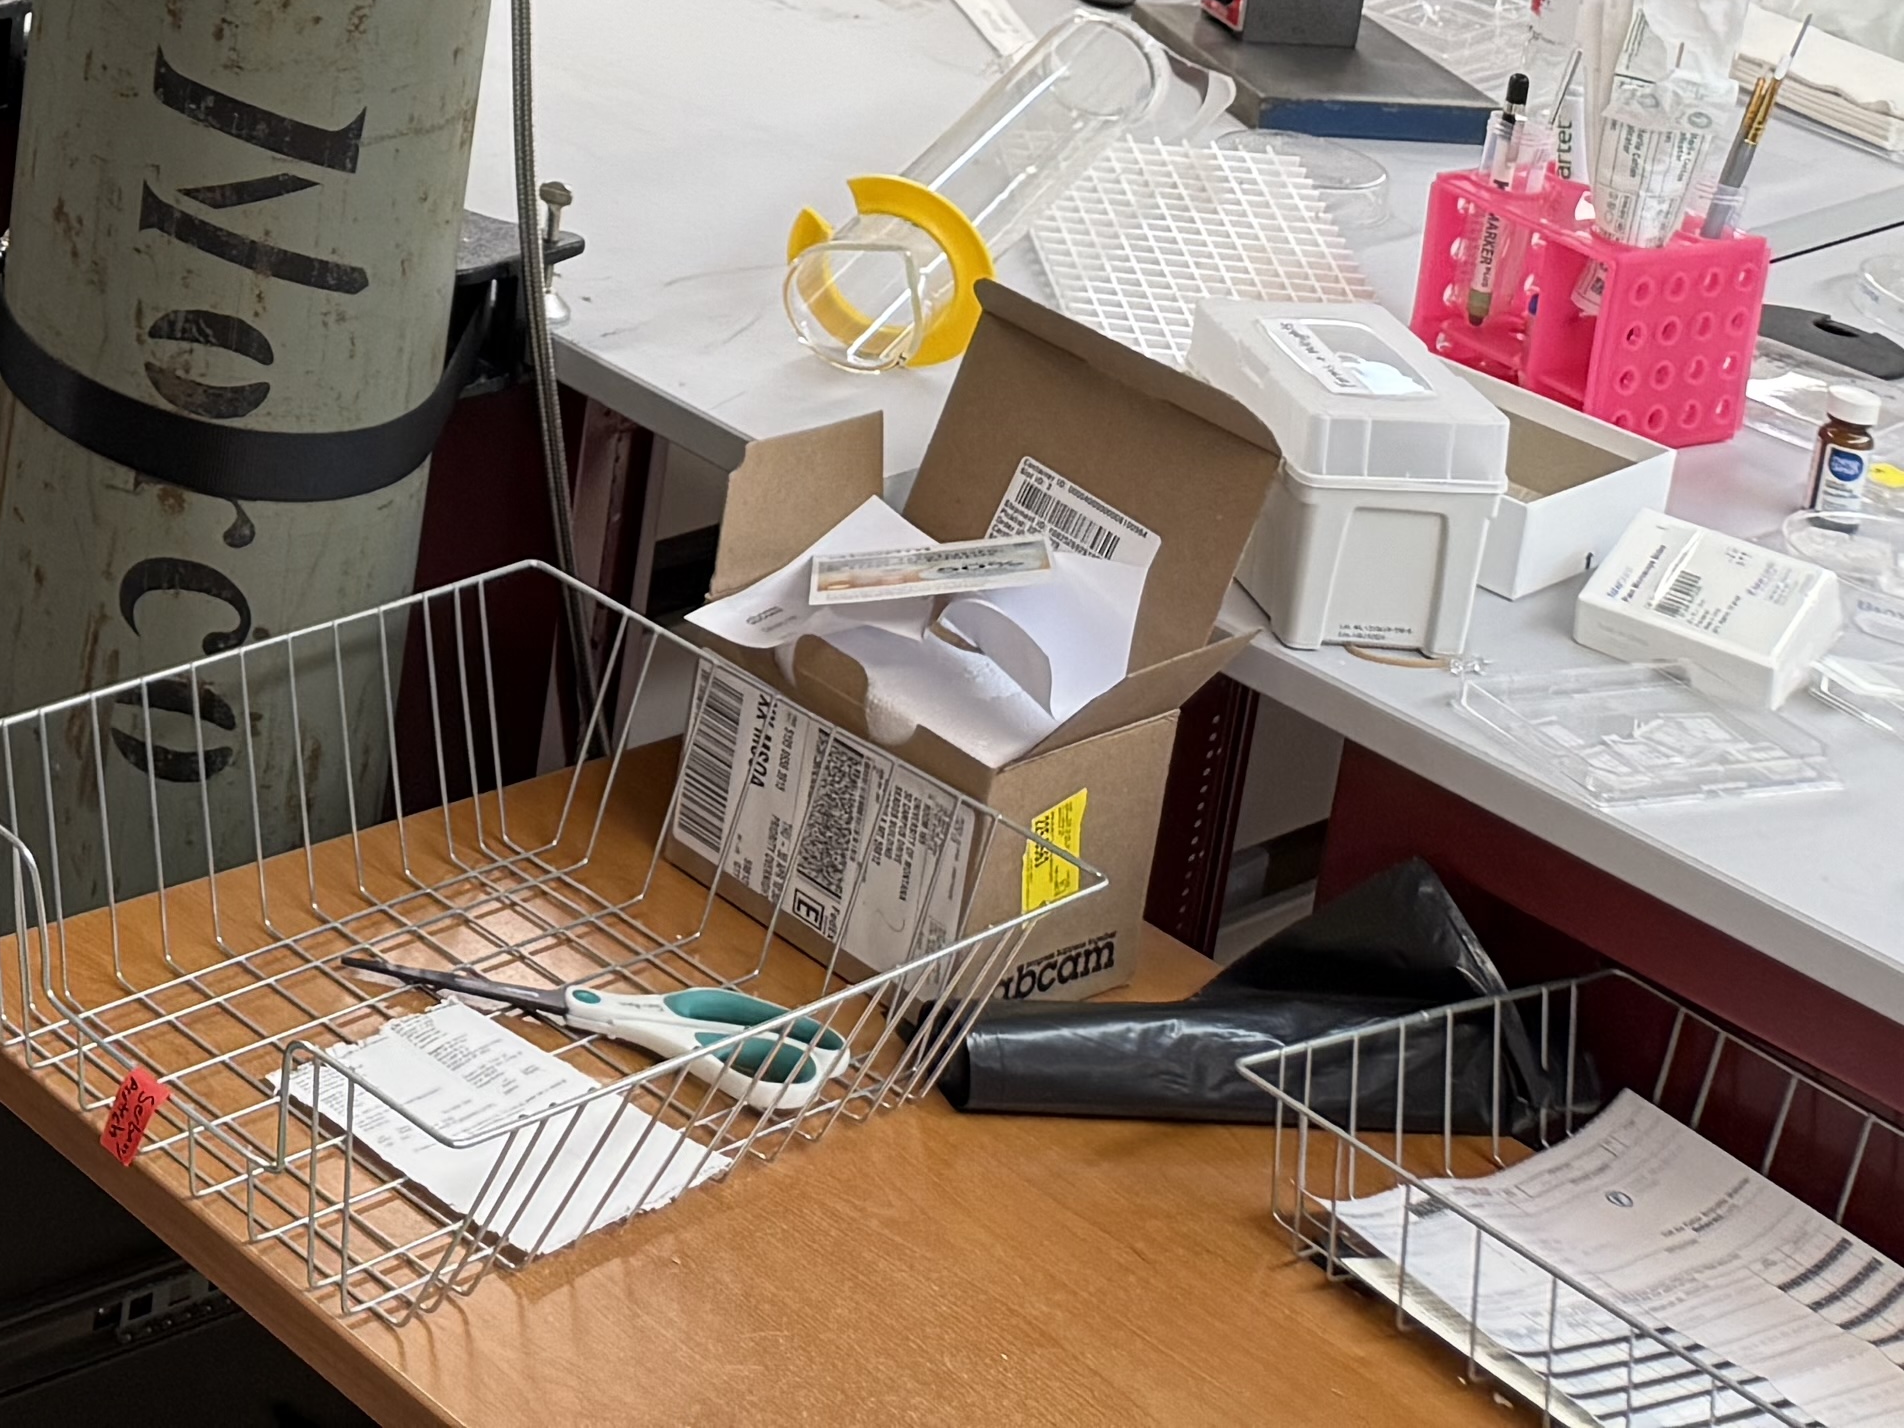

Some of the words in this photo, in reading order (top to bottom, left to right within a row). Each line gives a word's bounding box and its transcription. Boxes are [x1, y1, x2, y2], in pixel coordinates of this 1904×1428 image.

[1479, 213, 1501, 266] MARKER
[111, 45, 371, 784] Noco
[748, 726, 776, 789] MSOA
[768, 813, 782, 853] PRIORITY
[780, 822, 794, 840] THU
[885, 819, 900, 861] BUILDING
[896, 802, 911, 839] CAMPUS
[905, 797, 922, 846] UNIVERSITY
[893, 841, 906, 866] DRIVE
[905, 847, 913, 861] OF
[760, 853, 775, 898] OVERNIGH
[898, 861, 912, 902] MONTANA
[796, 898, 821, 924] E
[993, 940, 1115, 1001] abcam
